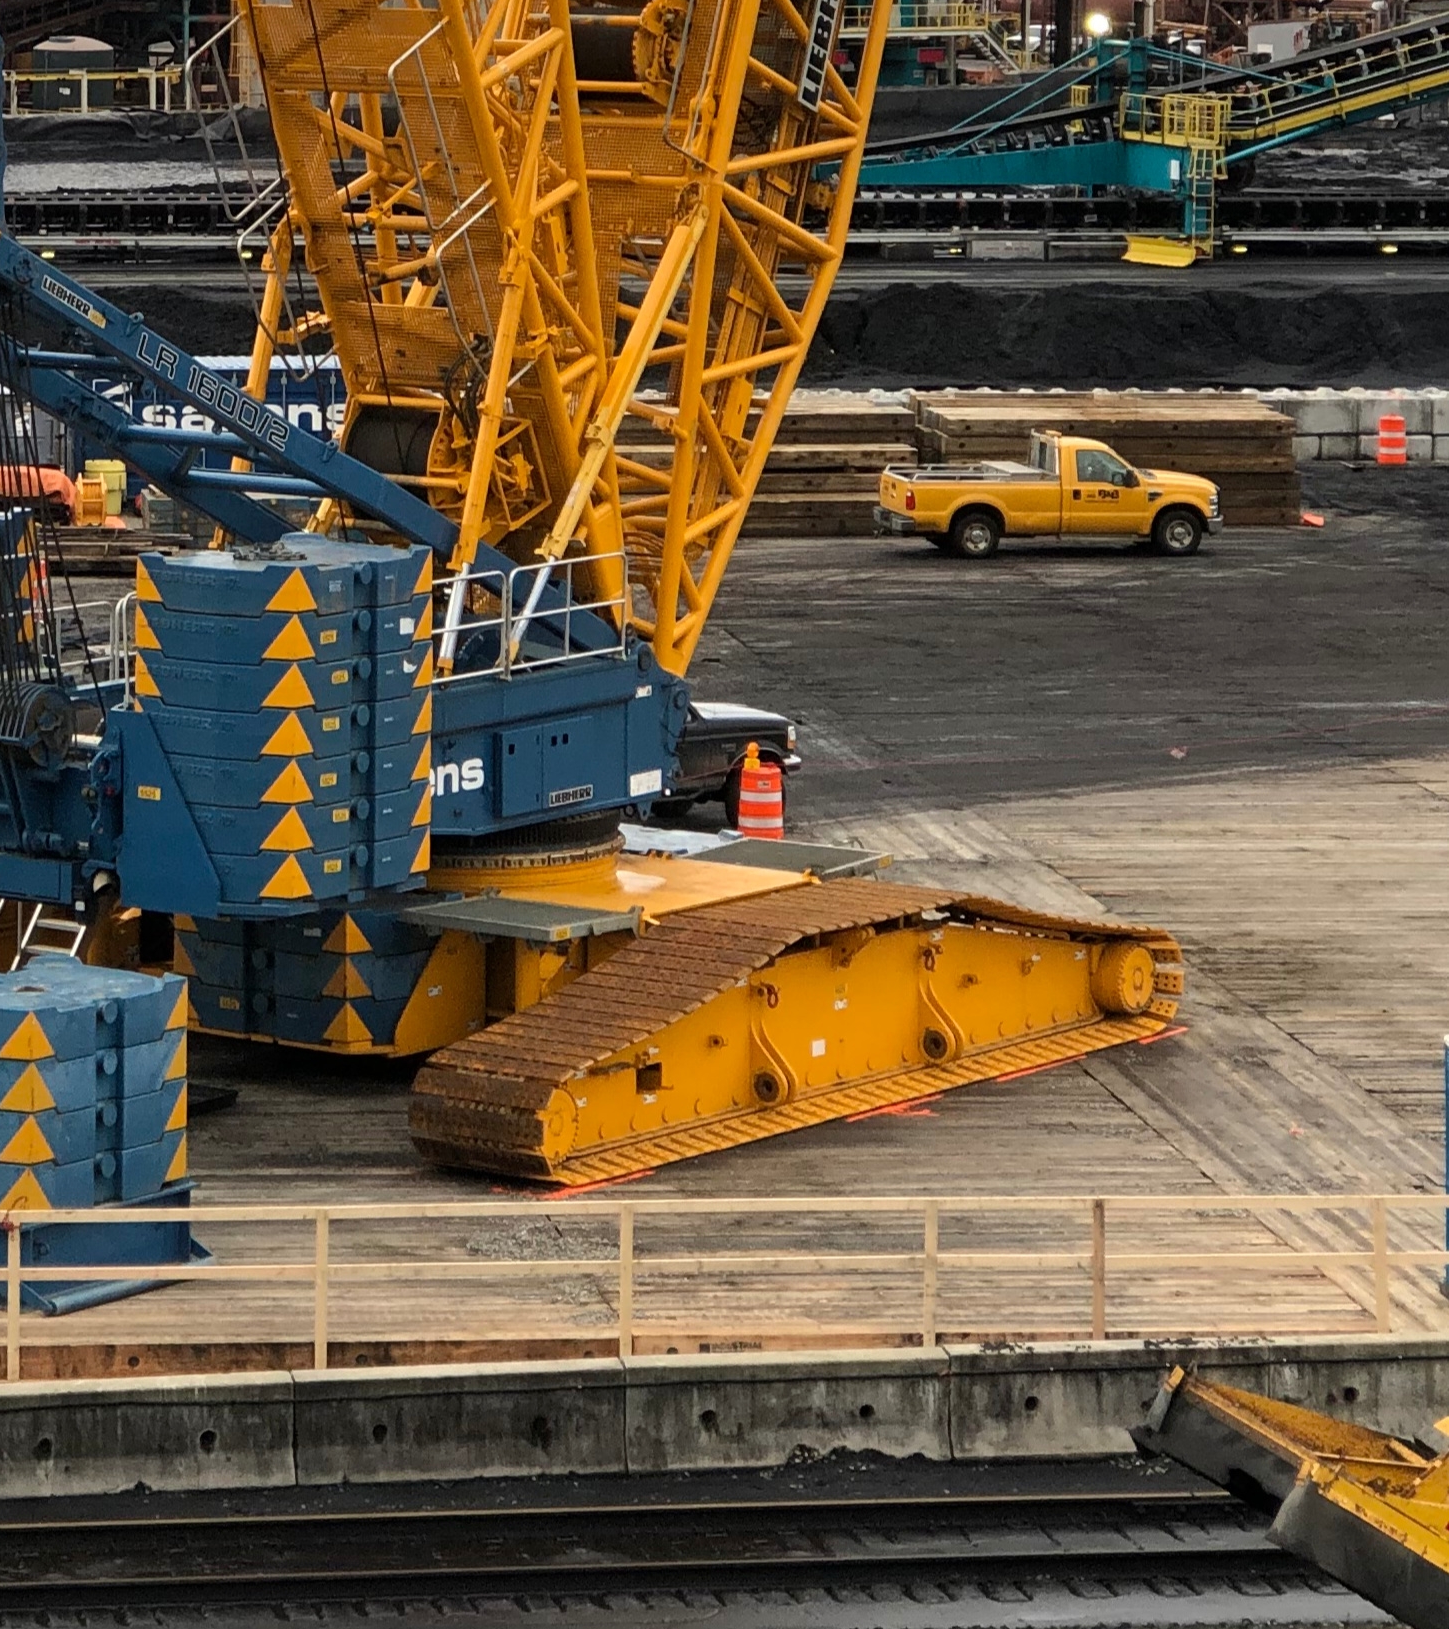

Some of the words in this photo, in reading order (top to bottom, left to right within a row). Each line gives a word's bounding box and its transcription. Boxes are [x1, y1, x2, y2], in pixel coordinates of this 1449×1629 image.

[42, 275, 91, 317] LIEBHERR
[136, 332, 179, 380] LR
[187, 365, 289, 452] 1600/2
[141, 402, 346, 432] sans
[550, 787, 593, 805] LIEBHERR
